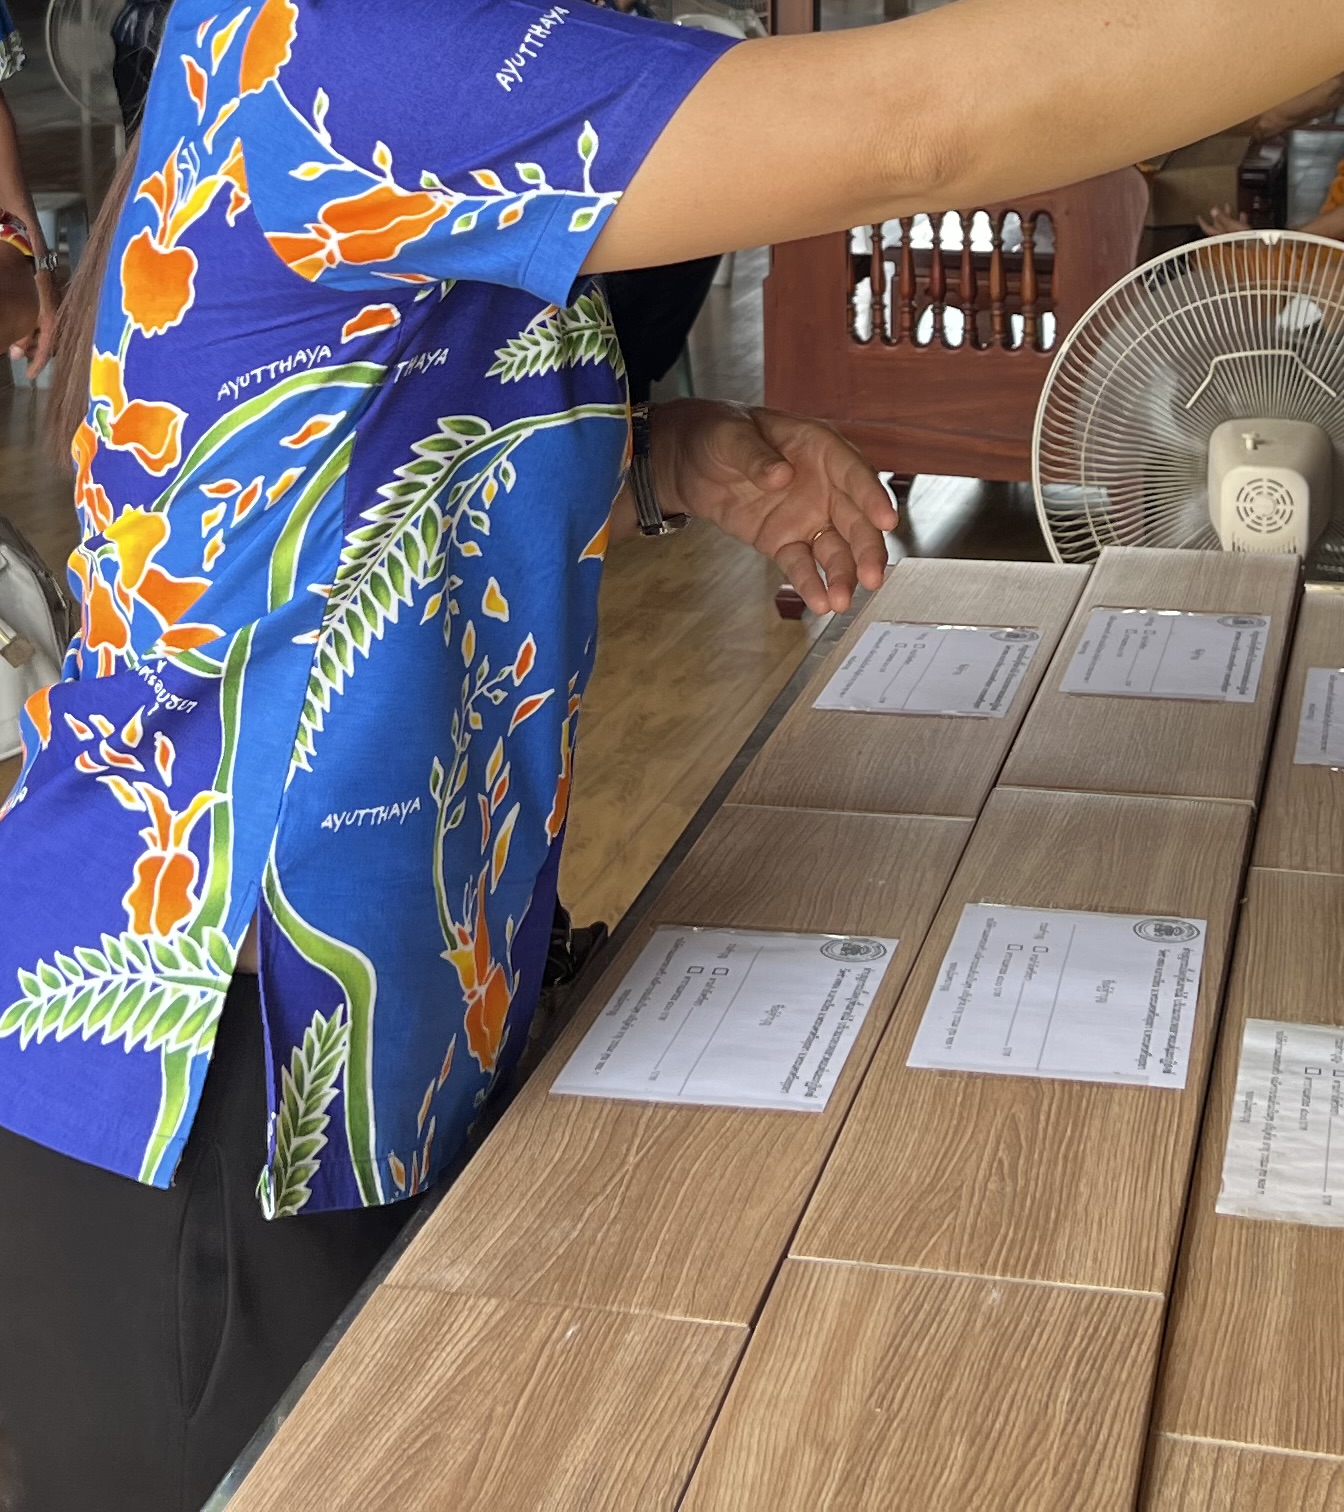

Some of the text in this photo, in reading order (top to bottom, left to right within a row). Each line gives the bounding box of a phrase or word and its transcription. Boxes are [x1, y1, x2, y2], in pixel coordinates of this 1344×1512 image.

[495, 5, 570, 93] AYUTTHAYA
[217, 345, 332, 402] AYUTTHAYA
[320, 796, 421, 833] AYUTTHAYA
